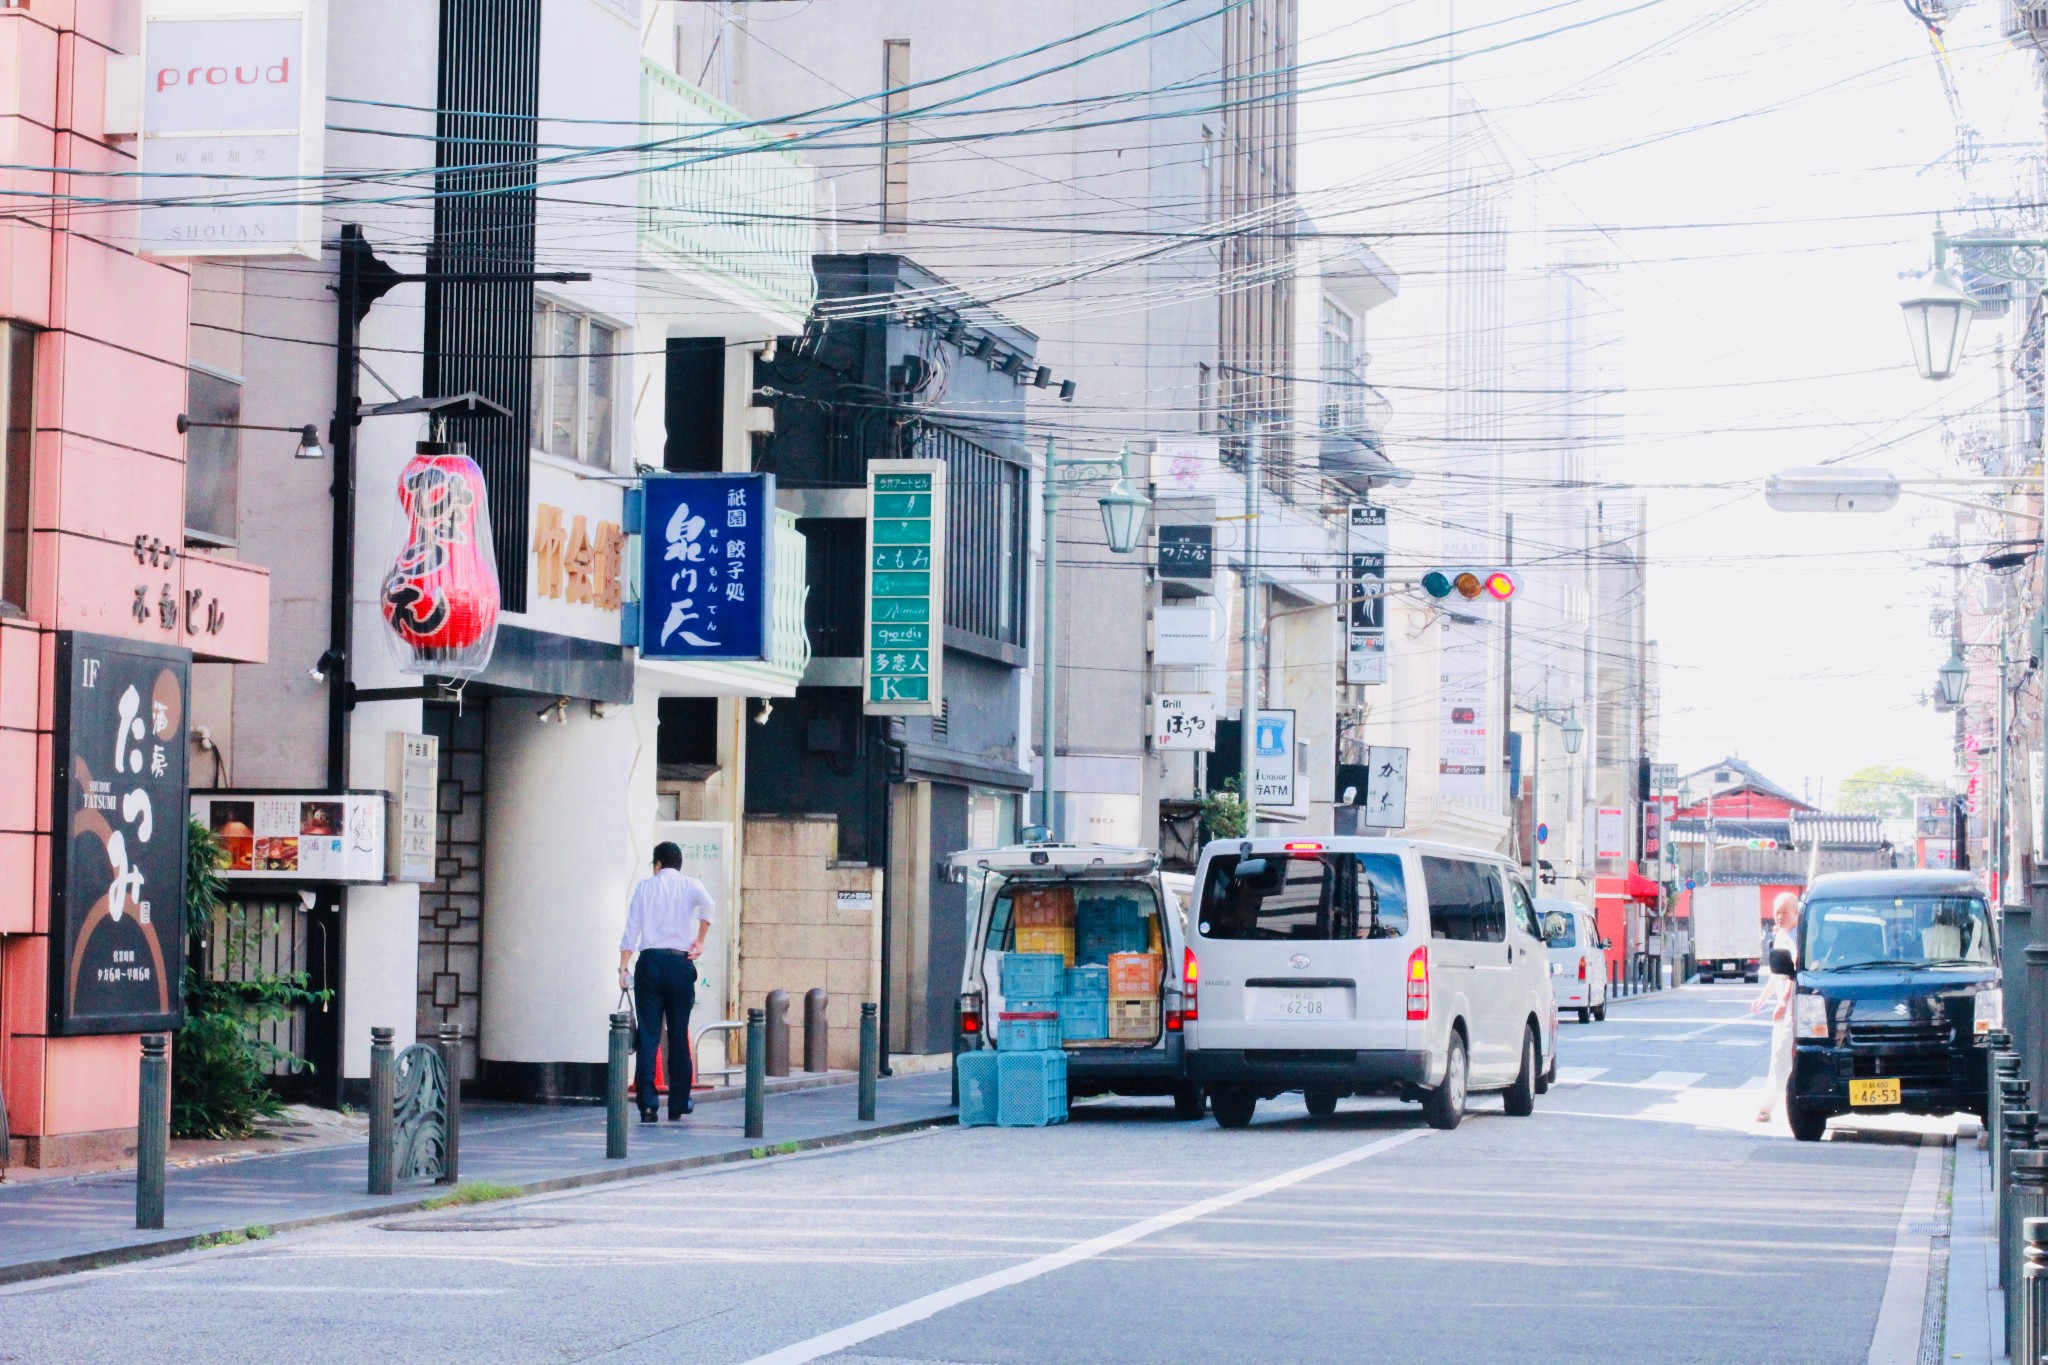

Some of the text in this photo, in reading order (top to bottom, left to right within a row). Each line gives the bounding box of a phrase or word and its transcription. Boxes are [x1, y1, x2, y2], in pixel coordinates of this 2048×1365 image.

[157, 57, 289, 93] proud
[172, 223, 265, 239] SHOUAN
[532, 502, 626, 611] 竹会館
[661, 502, 722, 647] 泉門天
[725, 539, 746, 602] 餃子処
[706, 528, 719, 631] せんもんてん
[1351, 633, 1384, 647] beyond
[876, 653, 927, 672] 多恋人
[82, 657, 100, 688] 1F
[1162, 699, 1182, 709] Grill
[1261, 773, 1287, 781] Liquor
[83, 794, 117, 810] TATSUMI
[105, 684, 154, 922] たつみ
[113, 950, 135, 963] 営業時間
[1287, 1001, 1322, 1014] 62-08
[1861, 1089, 1898, 1103] 46-53
